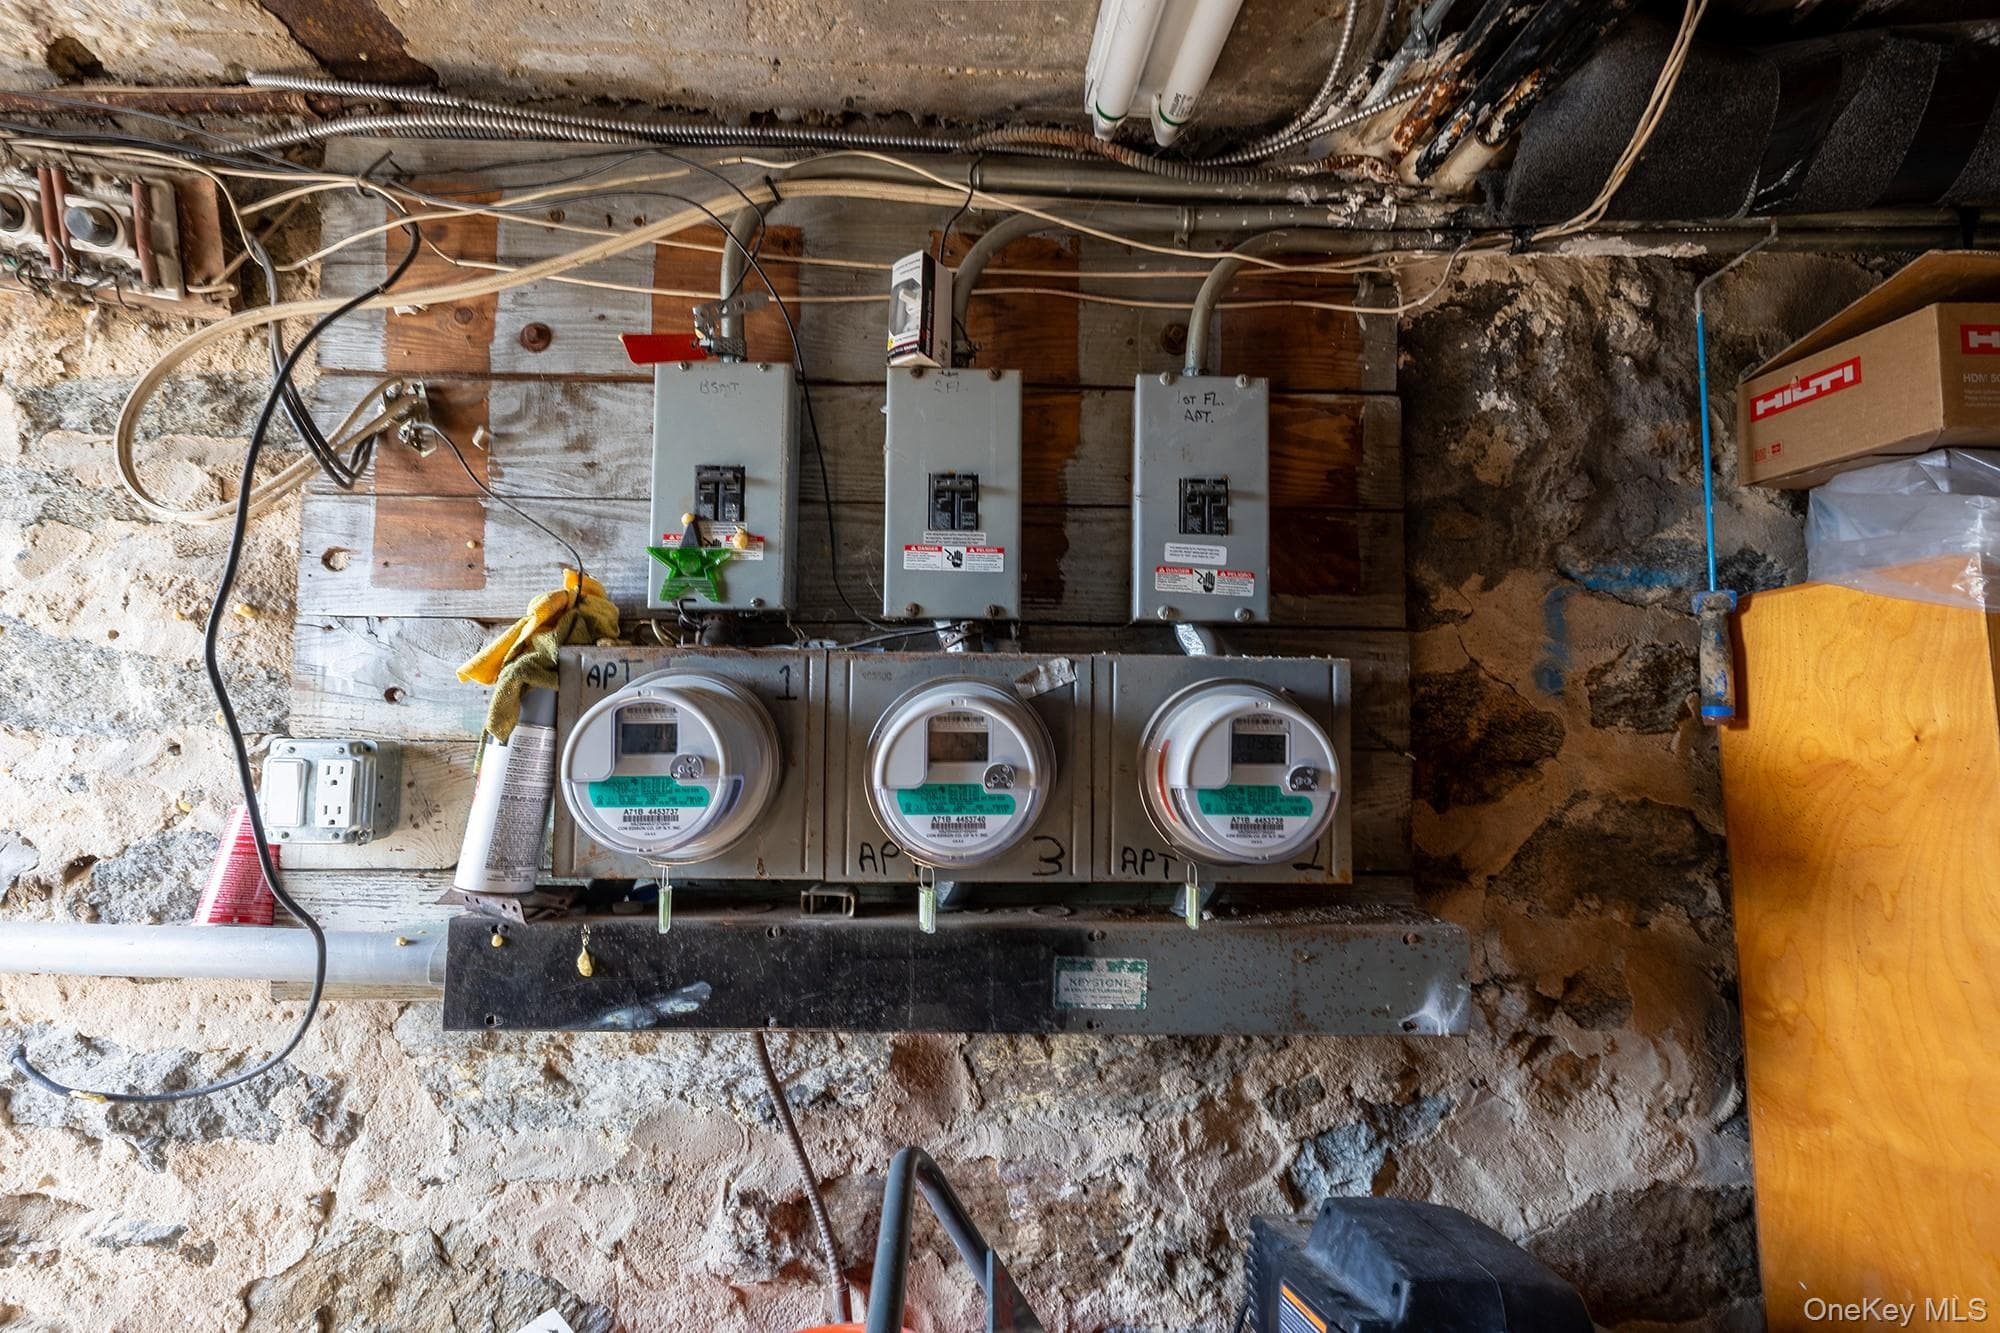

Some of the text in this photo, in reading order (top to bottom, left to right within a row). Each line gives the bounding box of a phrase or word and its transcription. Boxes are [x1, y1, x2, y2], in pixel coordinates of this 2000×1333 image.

[1755, 364, 1854, 417] HILTI
[586, 658, 798, 701] APT 1
[648, 808, 679, 816] 4453737
[1032, 835, 1066, 876] 3
[1121, 846, 1177, 880] APT
